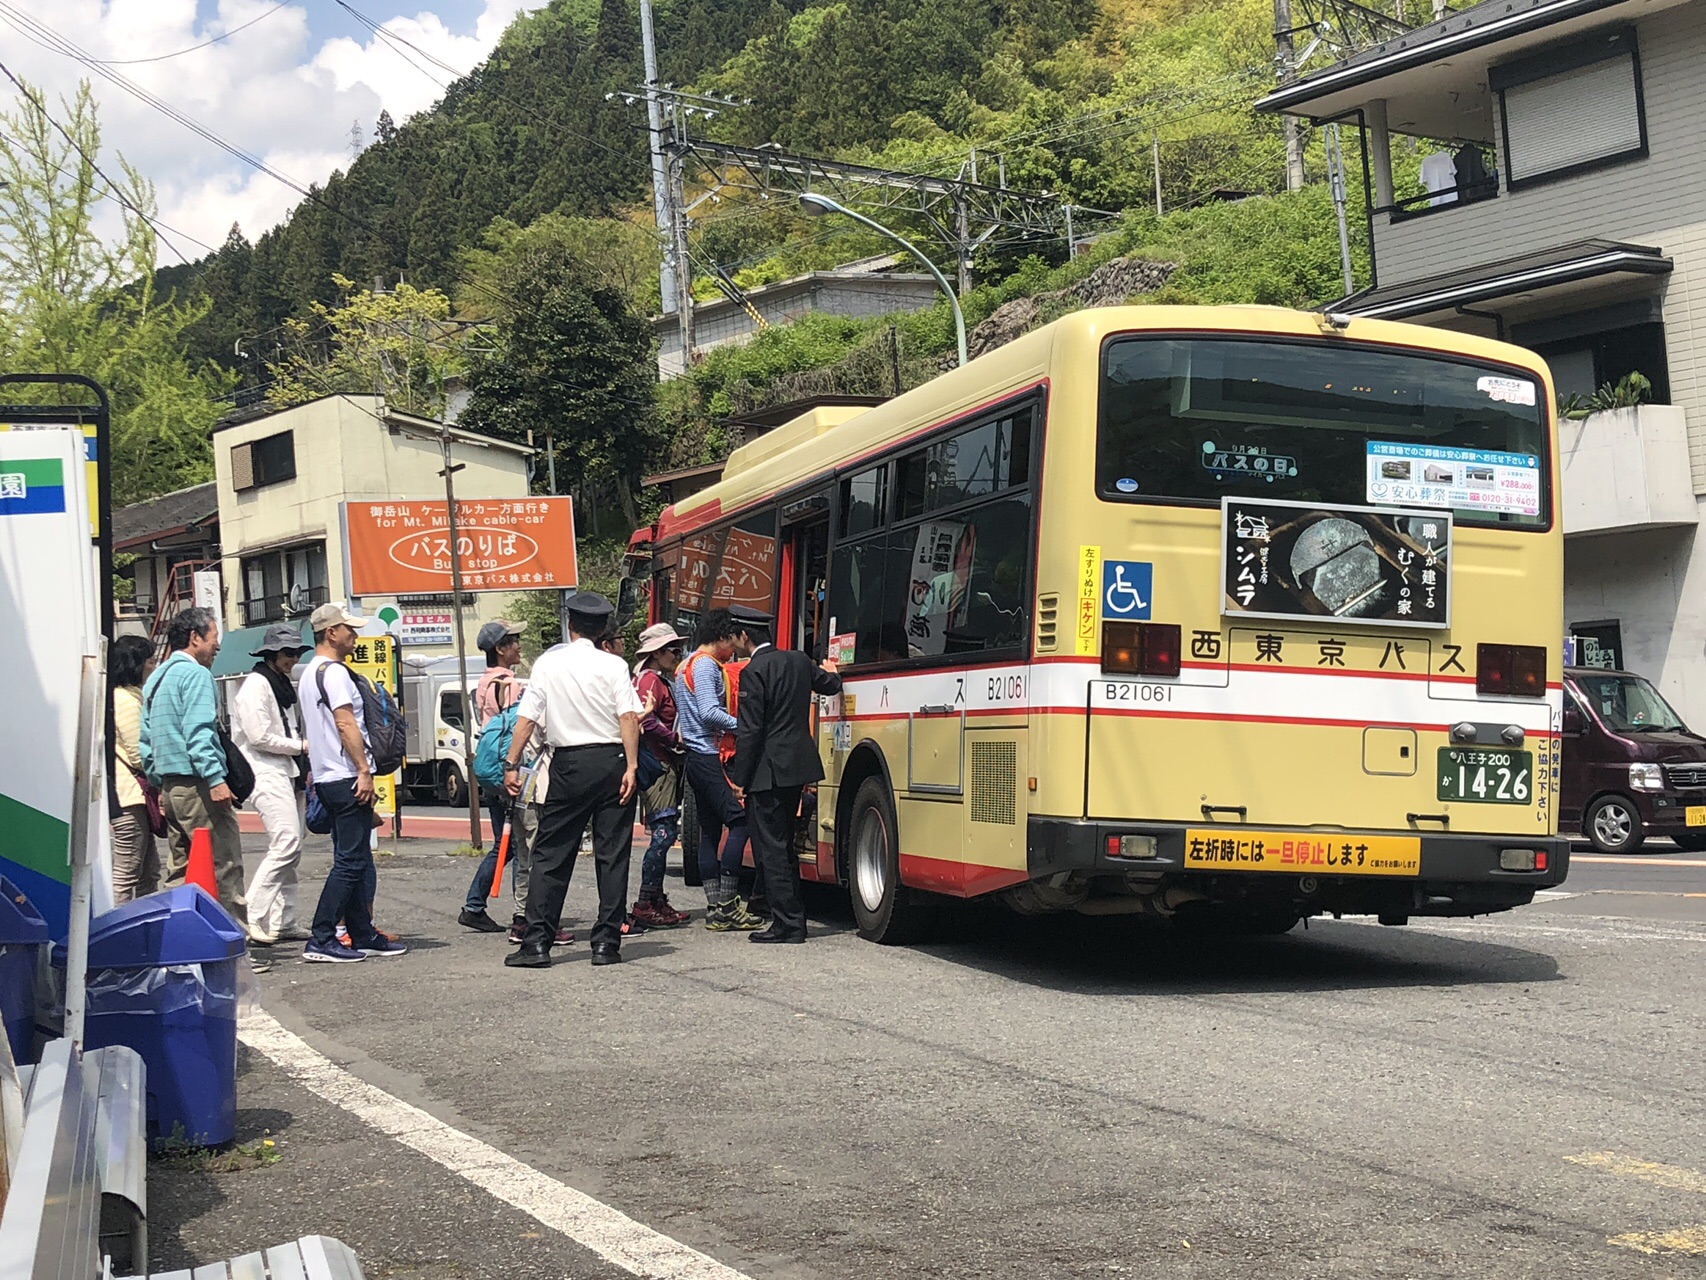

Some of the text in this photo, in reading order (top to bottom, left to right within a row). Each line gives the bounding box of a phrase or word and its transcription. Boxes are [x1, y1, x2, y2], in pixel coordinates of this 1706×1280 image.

[1212, 453, 1288, 473] バスの日
[1391, 484, 1446, 502] 安心葬祭
[370, 505, 410, 518] 御岳山
[376, 514, 545, 528] for Mt. Miake cable-car
[410, 534, 517, 557] バスのりば
[433, 558, 498, 570] Bu stop
[1235, 545, 1256, 606] シムラ
[1421, 523, 1438, 609] 職人が建てる
[1397, 547, 1415, 615] むくの家
[1190, 630, 1466, 673] 西東京バス
[988, 675, 1027, 701] B21061
[1105, 683, 1172, 702] B21061
[1551, 710, 1562, 793] バスの発車に
[1441, 765, 1529, 800] か 14-26
[1536, 738, 1549, 822] ご協力下さい
[1189, 836, 1369, 867] 左折時には一旦停止します
